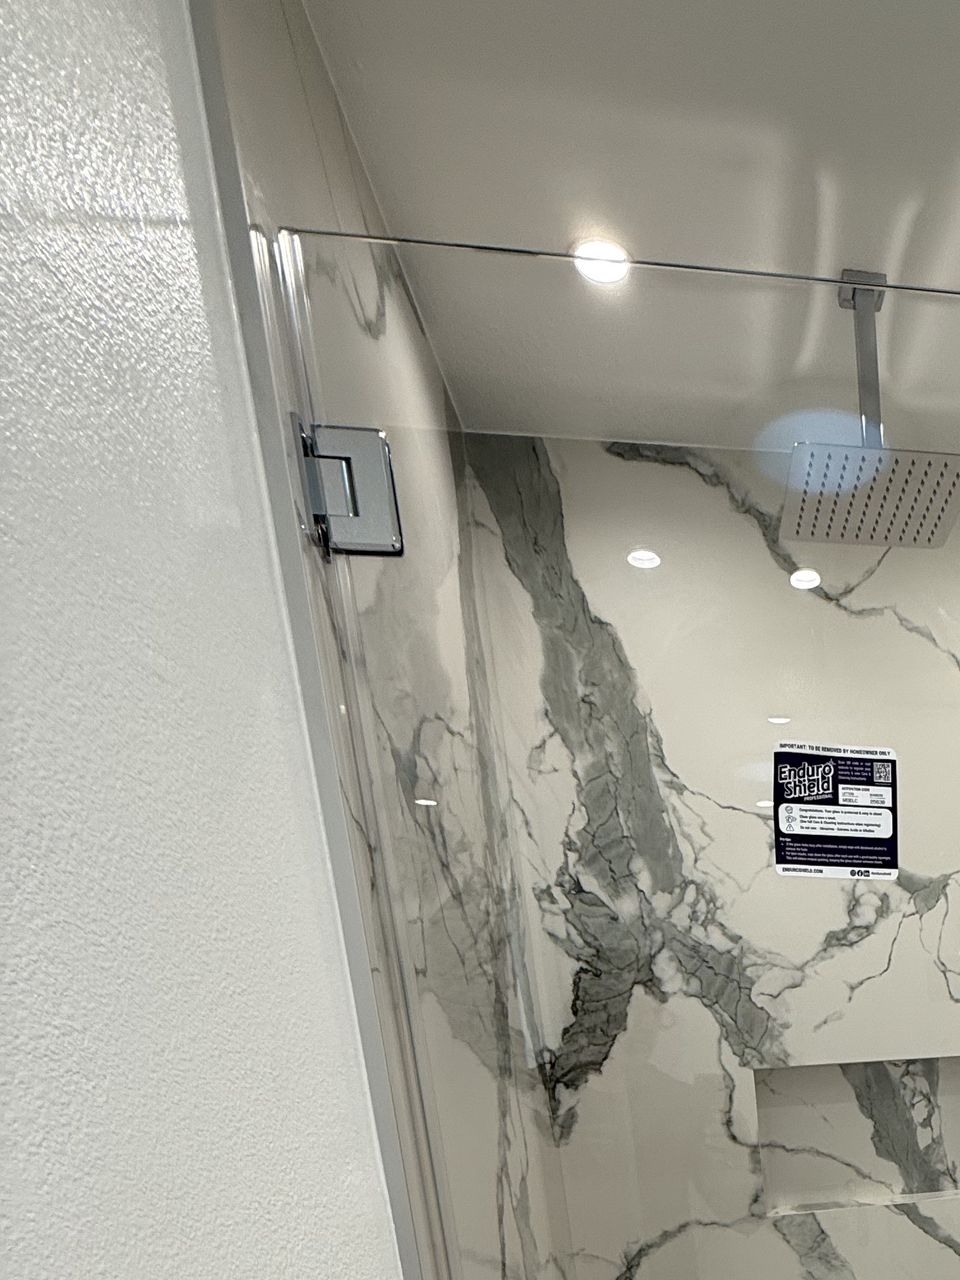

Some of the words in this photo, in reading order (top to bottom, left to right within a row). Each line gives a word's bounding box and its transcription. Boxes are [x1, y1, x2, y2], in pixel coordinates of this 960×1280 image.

[821, 746, 842, 754] REMOVED
[778, 761, 834, 783] Enduro
[784, 776, 833, 798] Shield
